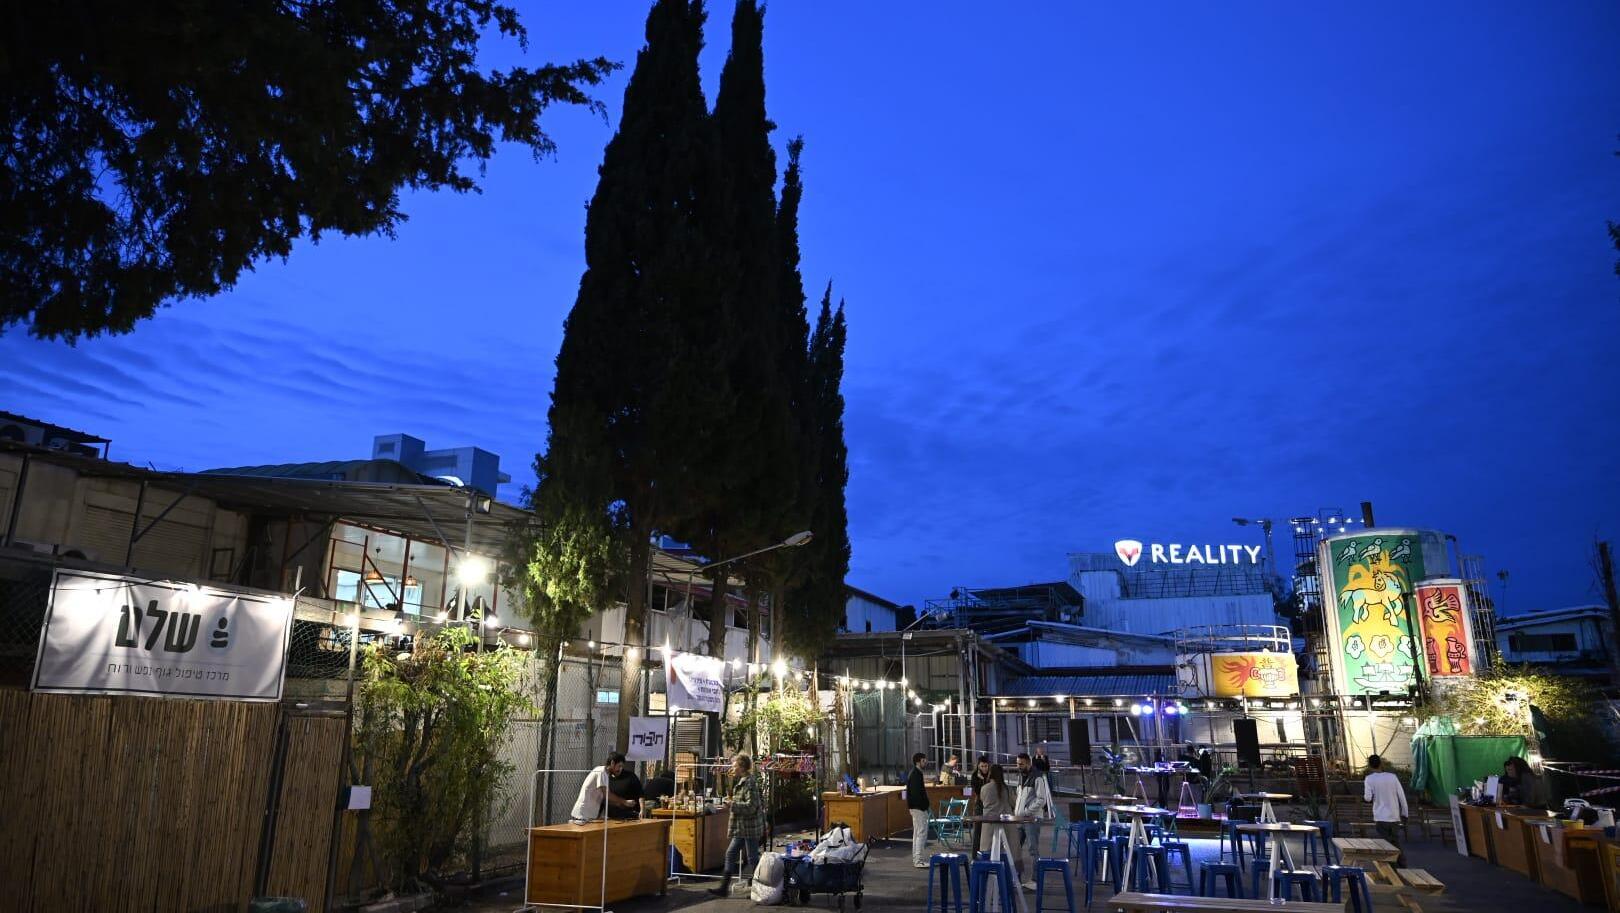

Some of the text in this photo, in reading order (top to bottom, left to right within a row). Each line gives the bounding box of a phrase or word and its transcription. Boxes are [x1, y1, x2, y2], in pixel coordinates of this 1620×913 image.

[1151, 543, 1261, 565] REALITY
[115, 599, 201, 654] שלם
[108, 663, 230, 681] מרכז טיפול גוף נפש ורוח
